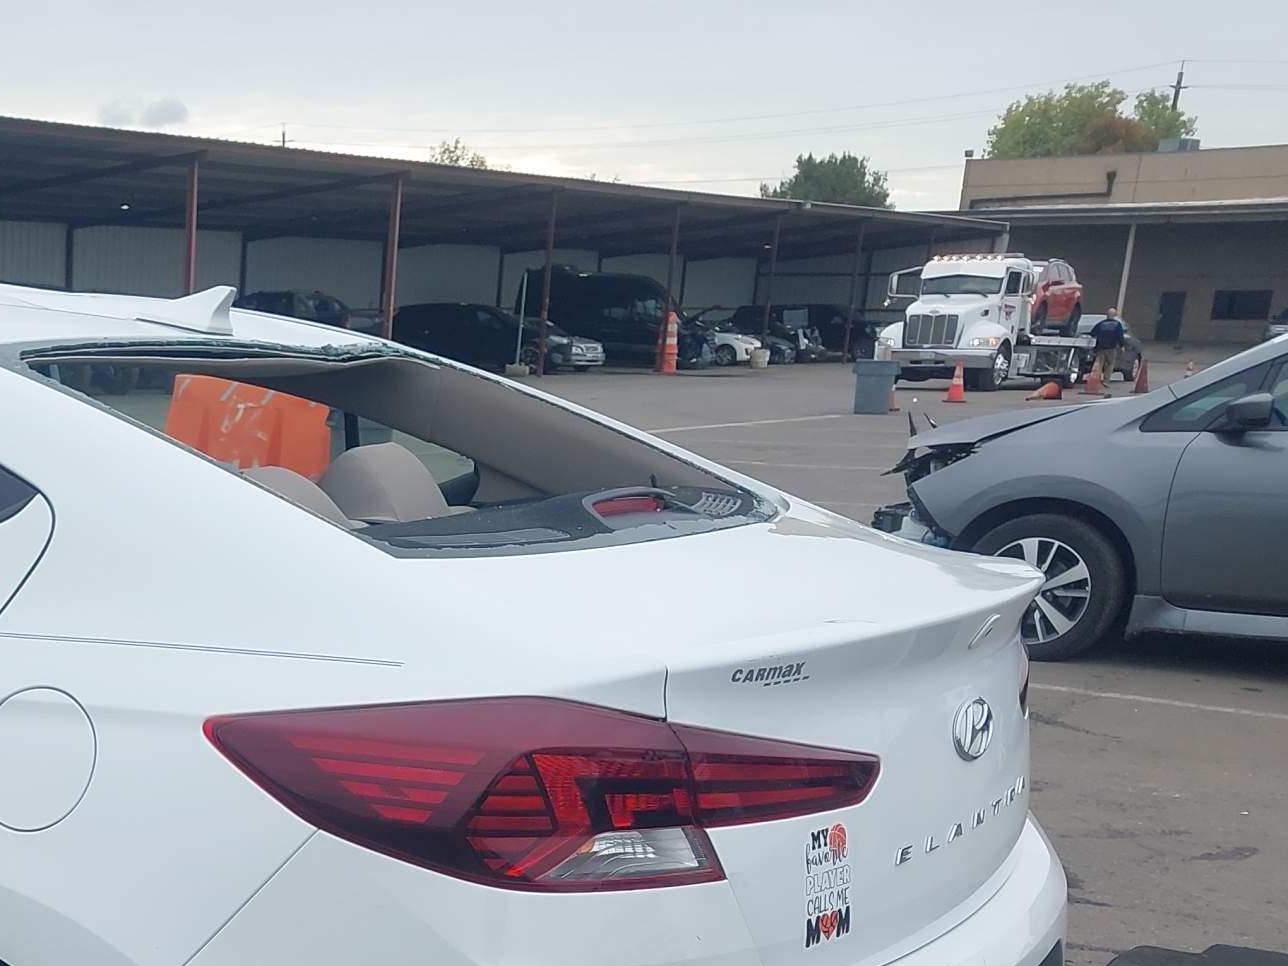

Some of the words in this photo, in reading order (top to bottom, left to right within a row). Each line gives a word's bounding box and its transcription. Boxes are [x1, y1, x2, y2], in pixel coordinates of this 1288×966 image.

[811, 827, 829, 851] MY
[806, 864, 851, 896] PLAYER
[807, 891, 834, 916] CALLS
[836, 886, 850, 908] ME
